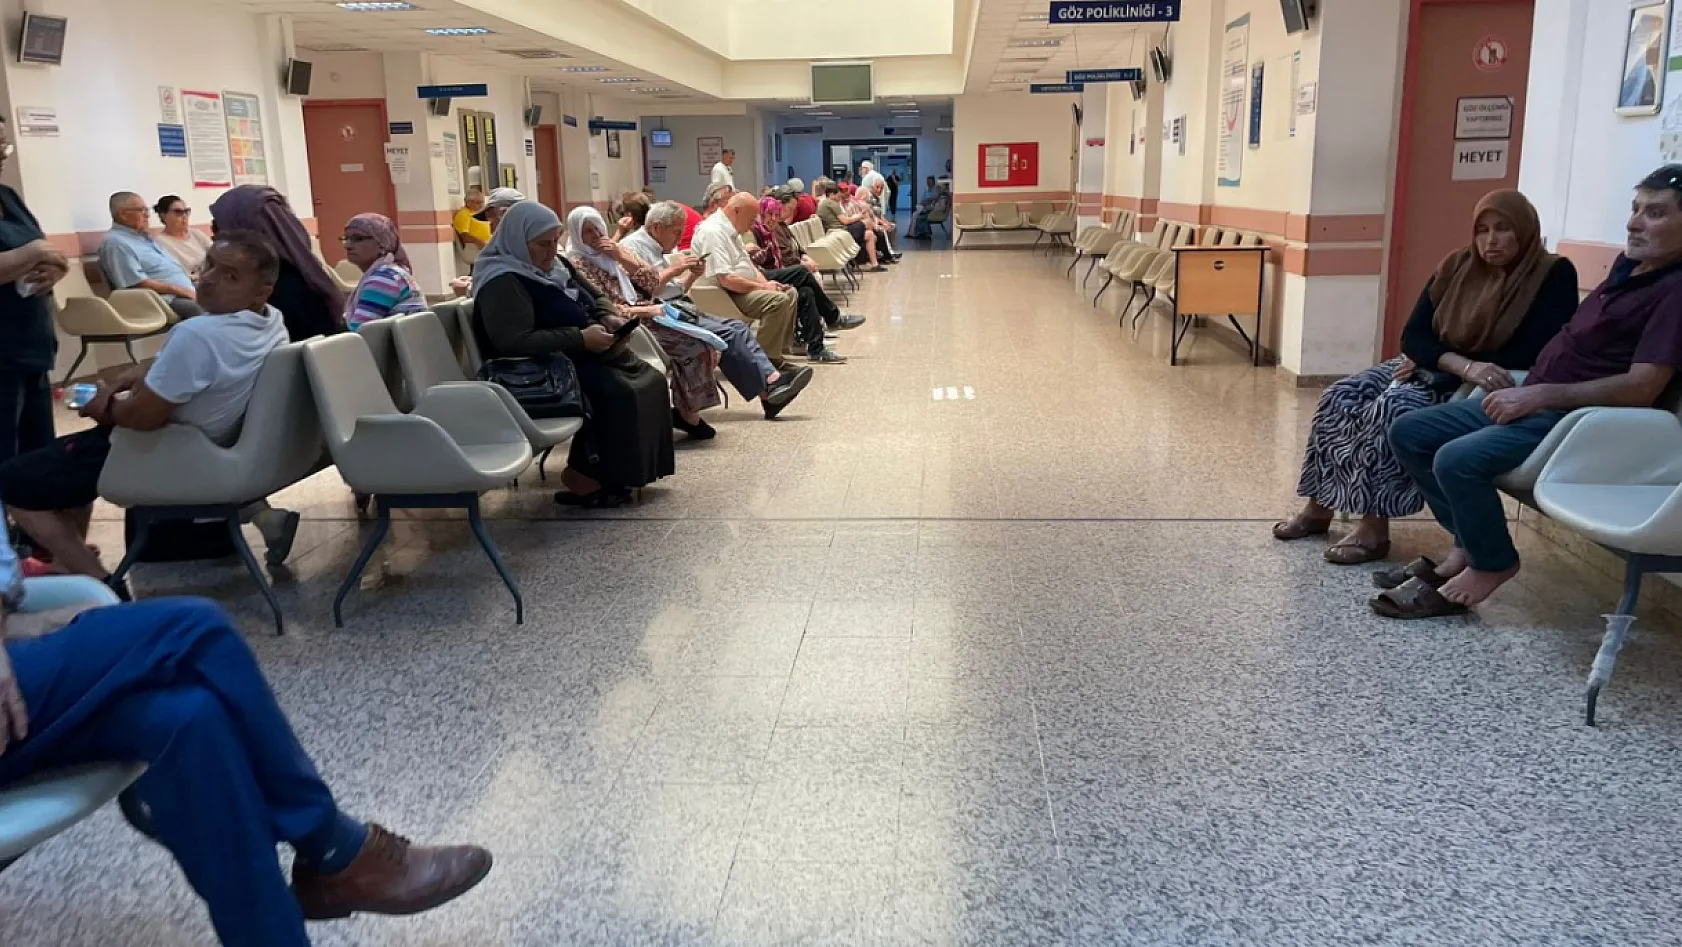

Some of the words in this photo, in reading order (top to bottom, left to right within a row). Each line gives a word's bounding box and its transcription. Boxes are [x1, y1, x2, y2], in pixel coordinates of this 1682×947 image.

[1058, 4, 1083, 18] GÖZ
[1086, 4, 1155, 18] POLİKLİNİĞİ
[1166, 5, 1173, 17] 3
[1459, 150, 1503, 164] HEYET
